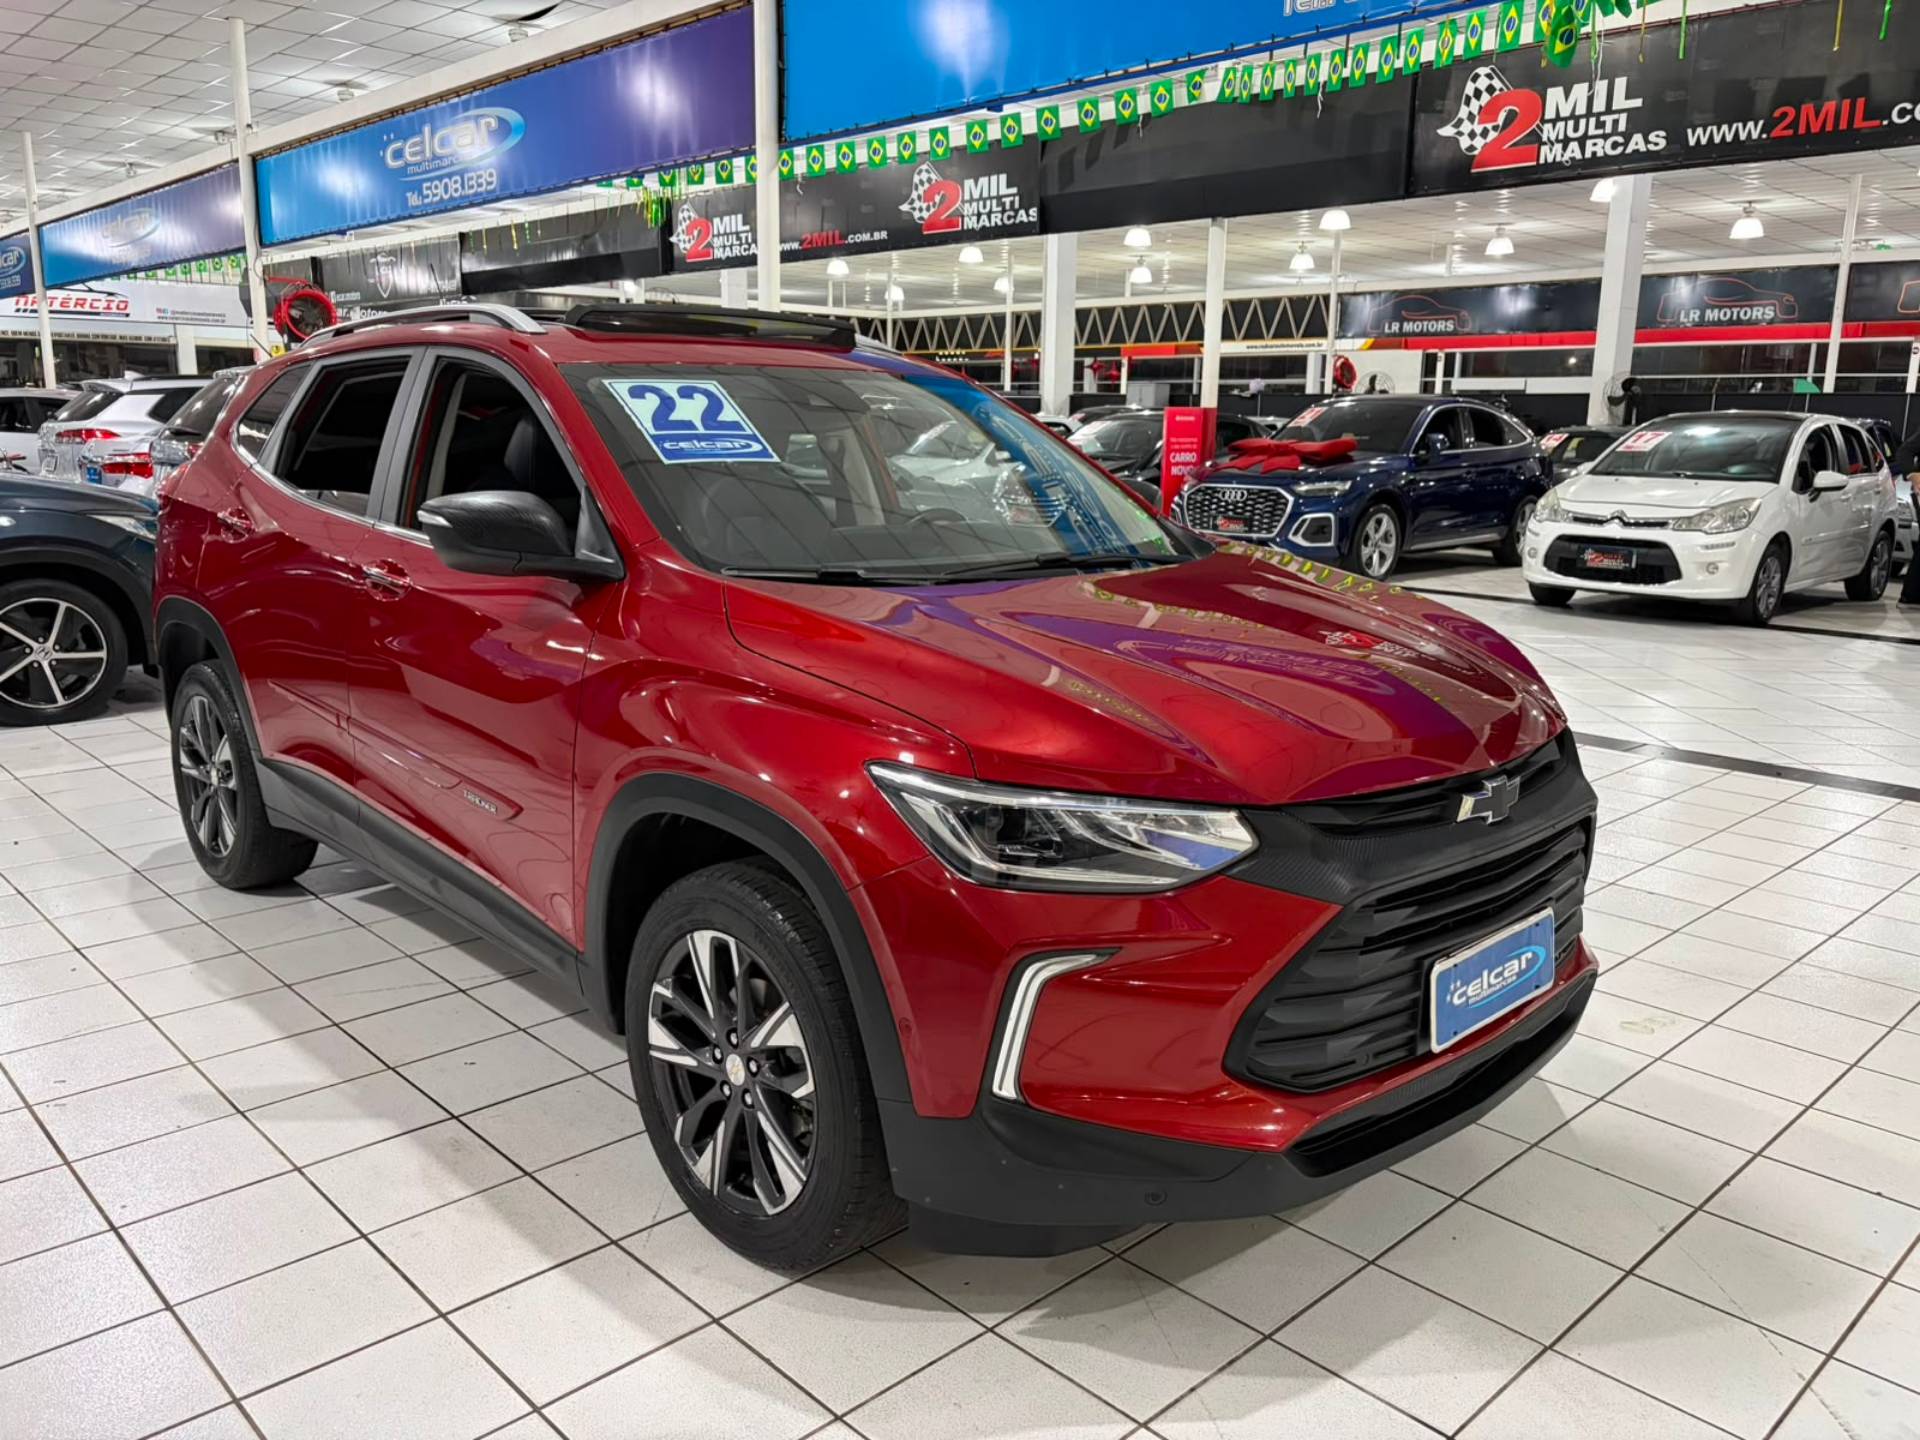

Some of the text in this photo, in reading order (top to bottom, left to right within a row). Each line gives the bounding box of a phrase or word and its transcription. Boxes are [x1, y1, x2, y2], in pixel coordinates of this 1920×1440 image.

[1471, 76, 1643, 172] 2 MIL
[1543, 112, 1628, 142] MULTI
[384, 115, 499, 169] celcar
[1539, 130, 1668, 165] MARCAS
[422, 168, 497, 202] 5908.1339
[922, 173, 1018, 234] 2 MIL
[963, 196, 1020, 215] MULTI
[963, 207, 1038, 231] MARCAS
[685, 214, 750, 262] 2 MIL
[713, 232, 751, 247] MULTI
[713, 246, 759, 260] MARCA
[1384, 320, 1455, 334] LR MOTORS
[1680, 305, 1775, 322] LR MOTORS
[627, 384, 748, 432] 22
[663, 439, 750, 451] celcar
[1169, 452, 1197, 463] CARRO
[1452, 951, 1534, 1006] celcar
